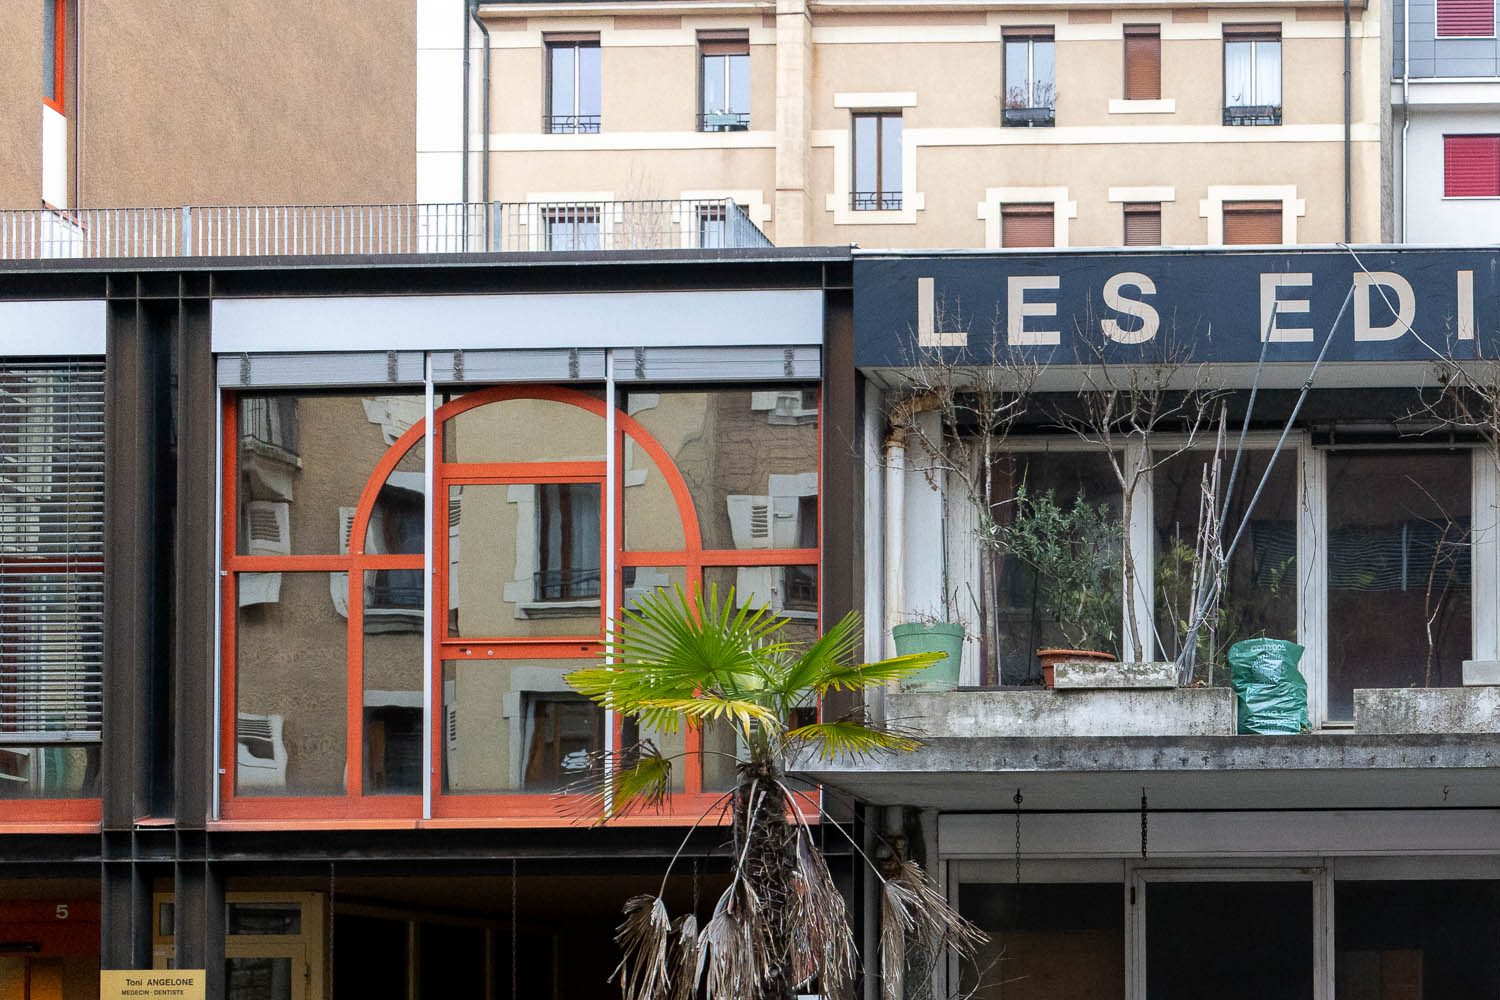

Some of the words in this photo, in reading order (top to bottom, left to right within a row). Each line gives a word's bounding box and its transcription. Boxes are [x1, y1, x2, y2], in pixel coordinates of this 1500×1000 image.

[917, 271, 1161, 347] LES
[56, 904, 69, 919] 5
[147, 978, 194, 986] ANGELONE
